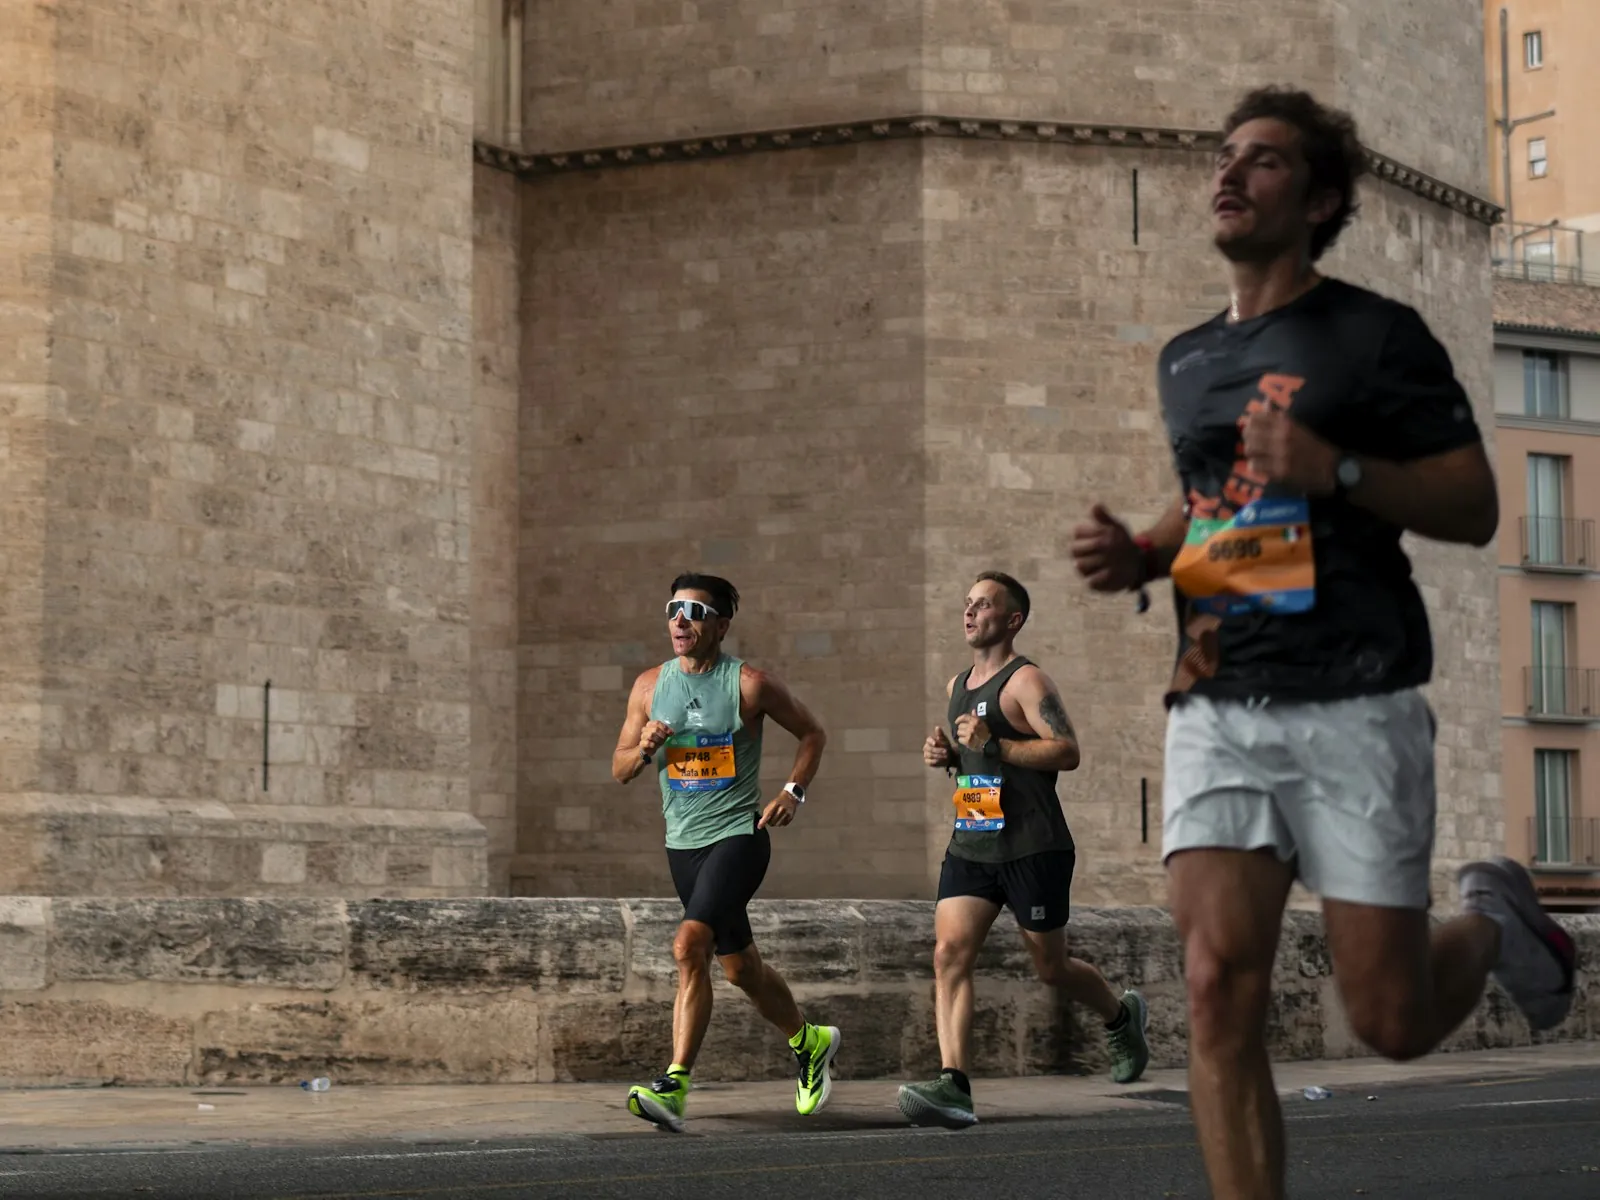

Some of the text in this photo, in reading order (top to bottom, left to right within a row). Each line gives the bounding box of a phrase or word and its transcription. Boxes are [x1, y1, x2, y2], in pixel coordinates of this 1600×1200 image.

[685, 752, 710, 761] 6748
[701, 768, 709, 776] M
[712, 767, 718, 776] A
